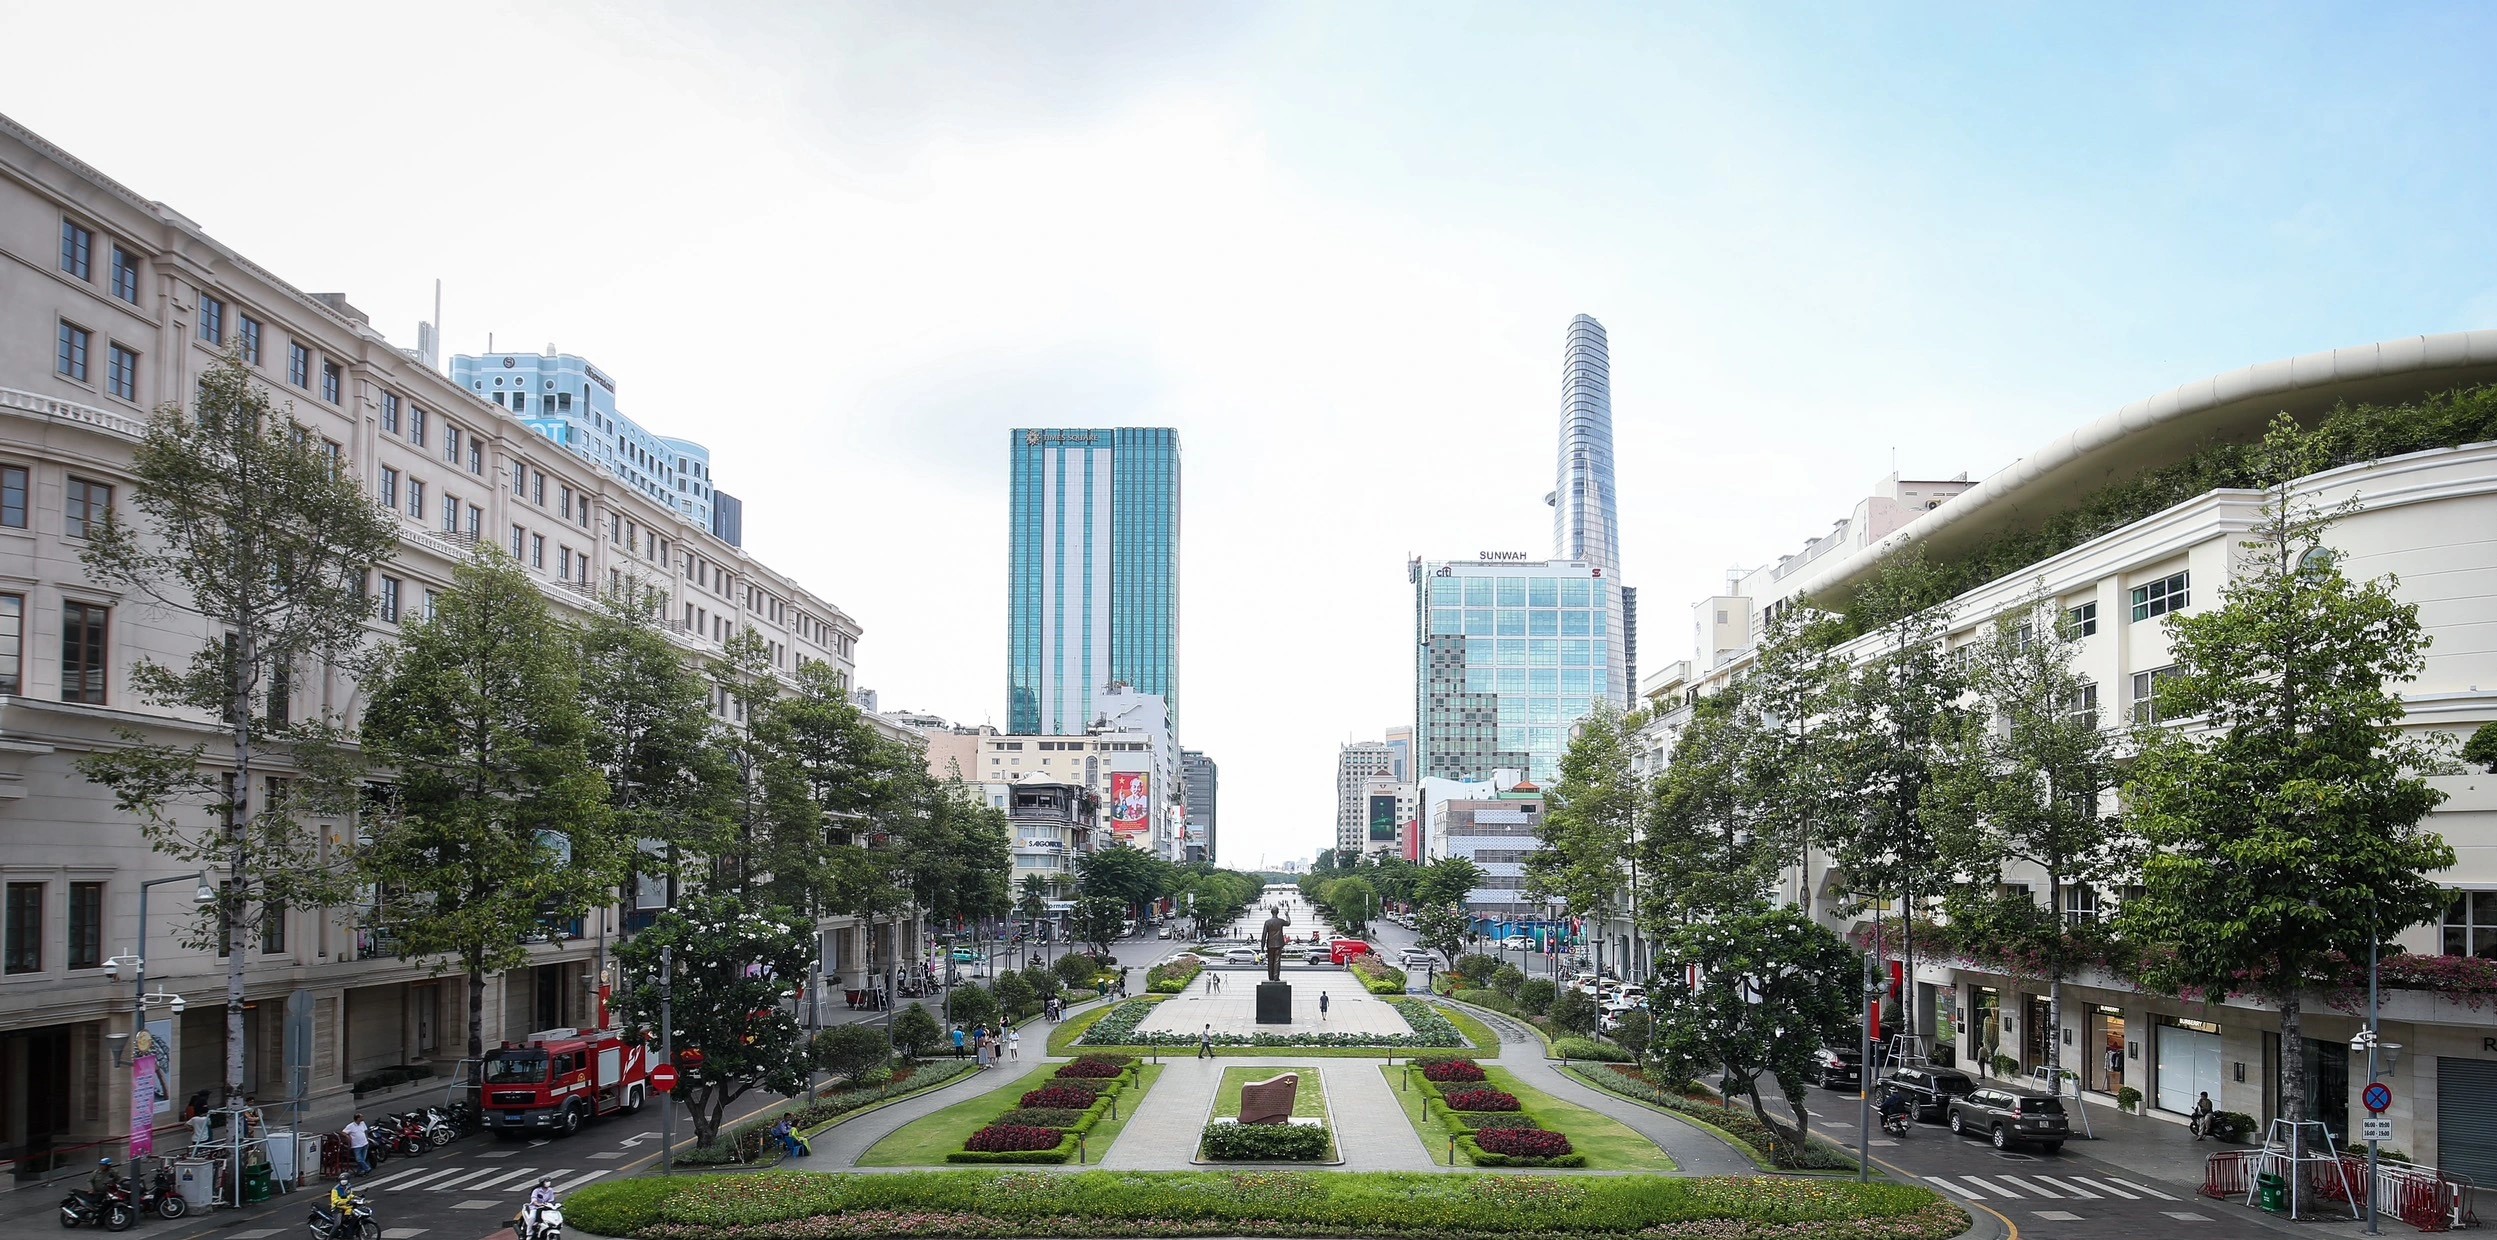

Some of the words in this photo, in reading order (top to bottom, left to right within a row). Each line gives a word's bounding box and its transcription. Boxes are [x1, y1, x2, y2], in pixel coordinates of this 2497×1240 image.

[584, 365, 614, 394] Sheraton
[1479, 551, 1527, 560] SUNWAH
[1436, 566, 1452, 577] citi
[2179, 1017, 2202, 1027] BURBERRY
